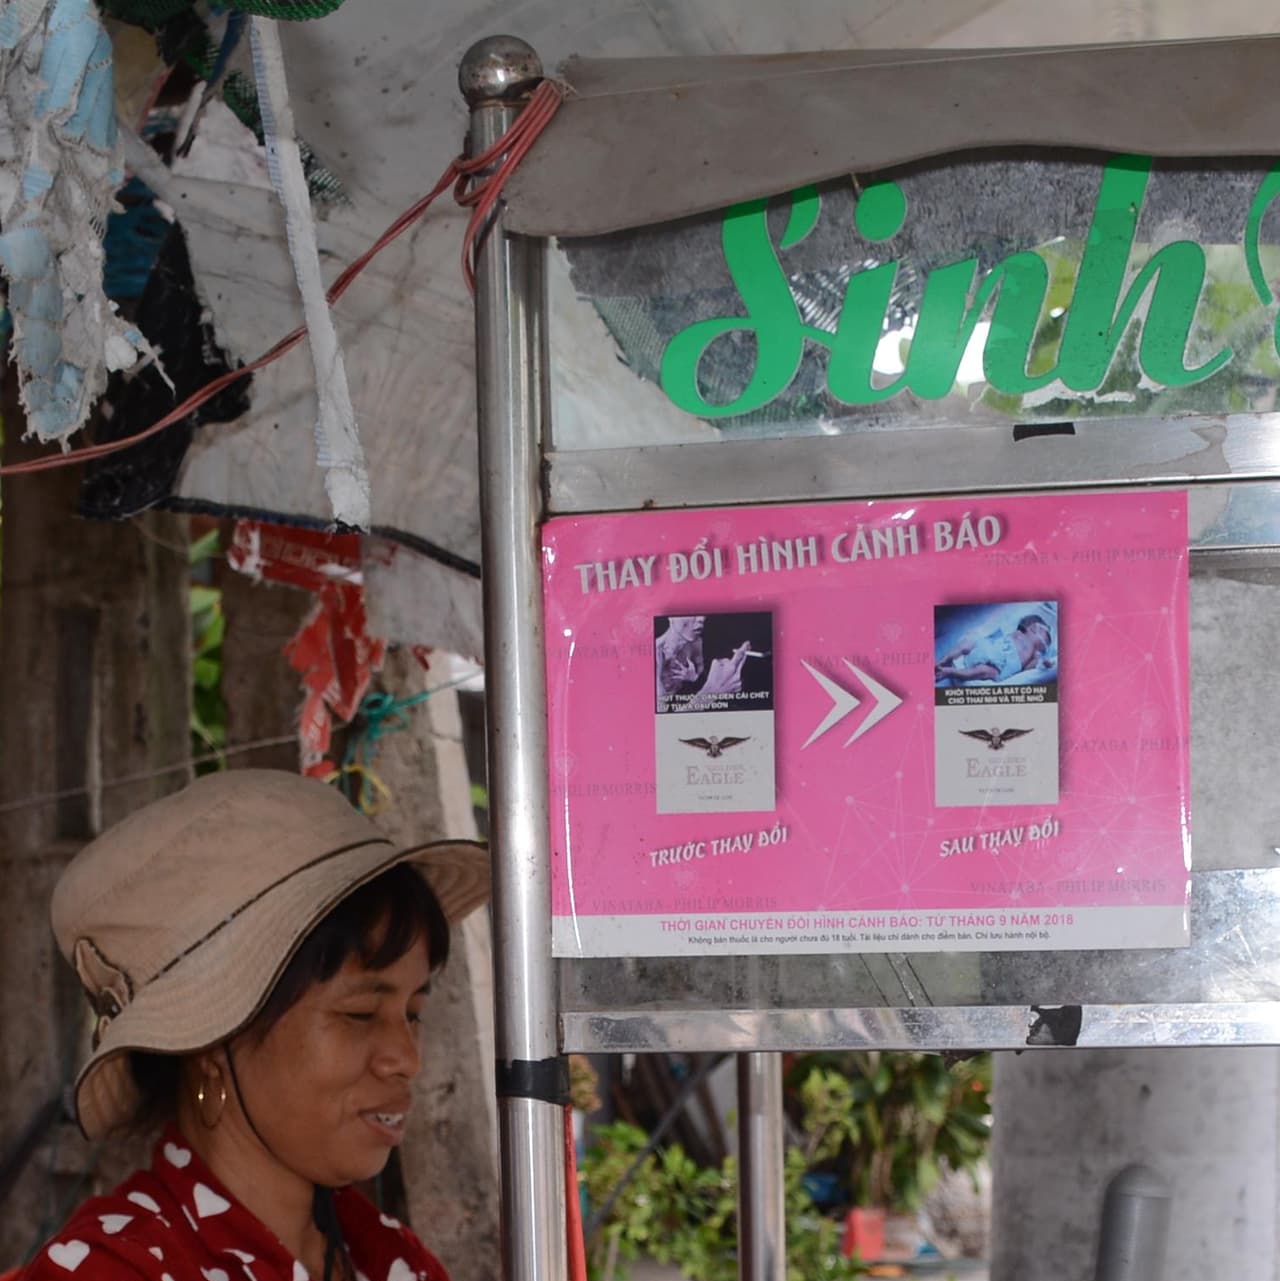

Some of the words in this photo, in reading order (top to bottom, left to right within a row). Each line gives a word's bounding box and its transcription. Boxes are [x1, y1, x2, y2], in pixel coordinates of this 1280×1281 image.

[660, 154, 1233, 419] Sinh
[574, 554, 656, 595] THAY
[668, 536, 723, 584] ĐỔI
[737, 535, 818, 576] HÌNH
[831, 524, 919, 563] CẢNH
[933, 512, 1001, 553] BÁO
[649, 840, 705, 868] TRƯỚC
[710, 832, 753, 856] THAY
[758, 820, 788, 847] ĐỔI
[939, 836, 975, 857] SAU
[979, 826, 1024, 849] THAY
[660, 917, 691, 931] THỜI
[695, 919, 725, 931] GIAN
[814, 914, 844, 929] HÌNH
[949, 912, 995, 927] THÁNG
[999, 914, 1007, 926] 9
[1044, 914, 1073, 926] 2018
[760, 935, 773, 943] cho
[921, 931, 935, 941] cho
